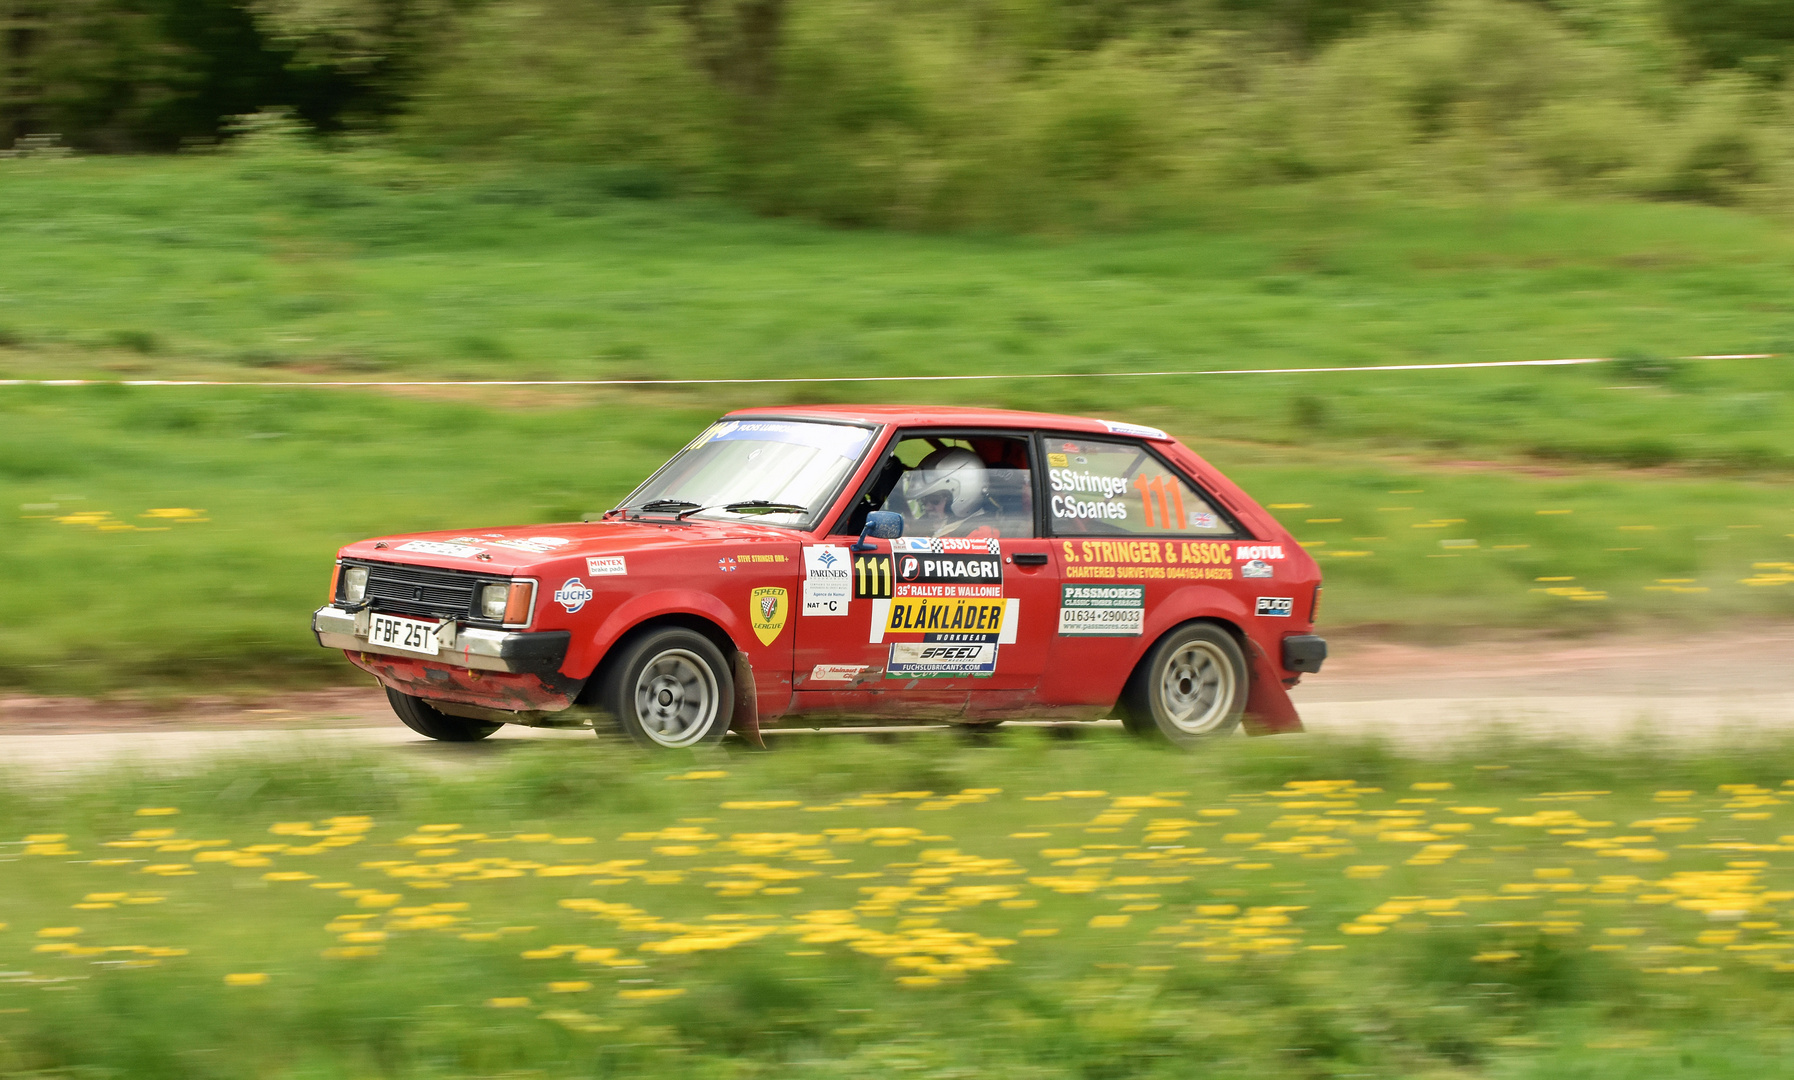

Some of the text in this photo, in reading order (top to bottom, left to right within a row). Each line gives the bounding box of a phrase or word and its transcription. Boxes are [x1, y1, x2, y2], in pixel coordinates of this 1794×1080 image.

[738, 423, 760, 432] FUCHS
[1049, 469, 1128, 499] S.Stringer
[1051, 495, 1128, 520] C.Soanes
[1133, 473, 1186, 530] 111
[943, 538, 970, 550] ESSO
[737, 555, 751, 563] STEVE
[1063, 541, 1232, 565] S. STRINGER & ASSOC
[1236, 546, 1285, 560] MOTUL
[590, 559, 623, 567] MINTEX
[924, 560, 999, 578] PIRAGRI
[810, 569, 848, 578] PARTNERS
[855, 556, 891, 596] 111
[1066, 566, 1116, 578] CHARTERED
[1117, 566, 1166, 578] SURVEYORS
[555, 590, 593, 601] FUCHS
[754, 588, 785, 597] SPEED
[911, 585, 943, 597] RALLYE
[944, 586, 956, 597] DE
[957, 586, 1001, 597] WALLONIE
[1064, 587, 1142, 599] PASSMORES
[1257, 599, 1292, 610] auto
[890, 599, 1002, 630] BLÅKLÄDER
[374, 617, 431, 649] FBF 25T
[1063, 623, 1139, 631] www.passmores.co.uk
[920, 645, 982, 659] SPEED
[902, 663, 981, 672] FUCHSLUBRICANTS.COM
